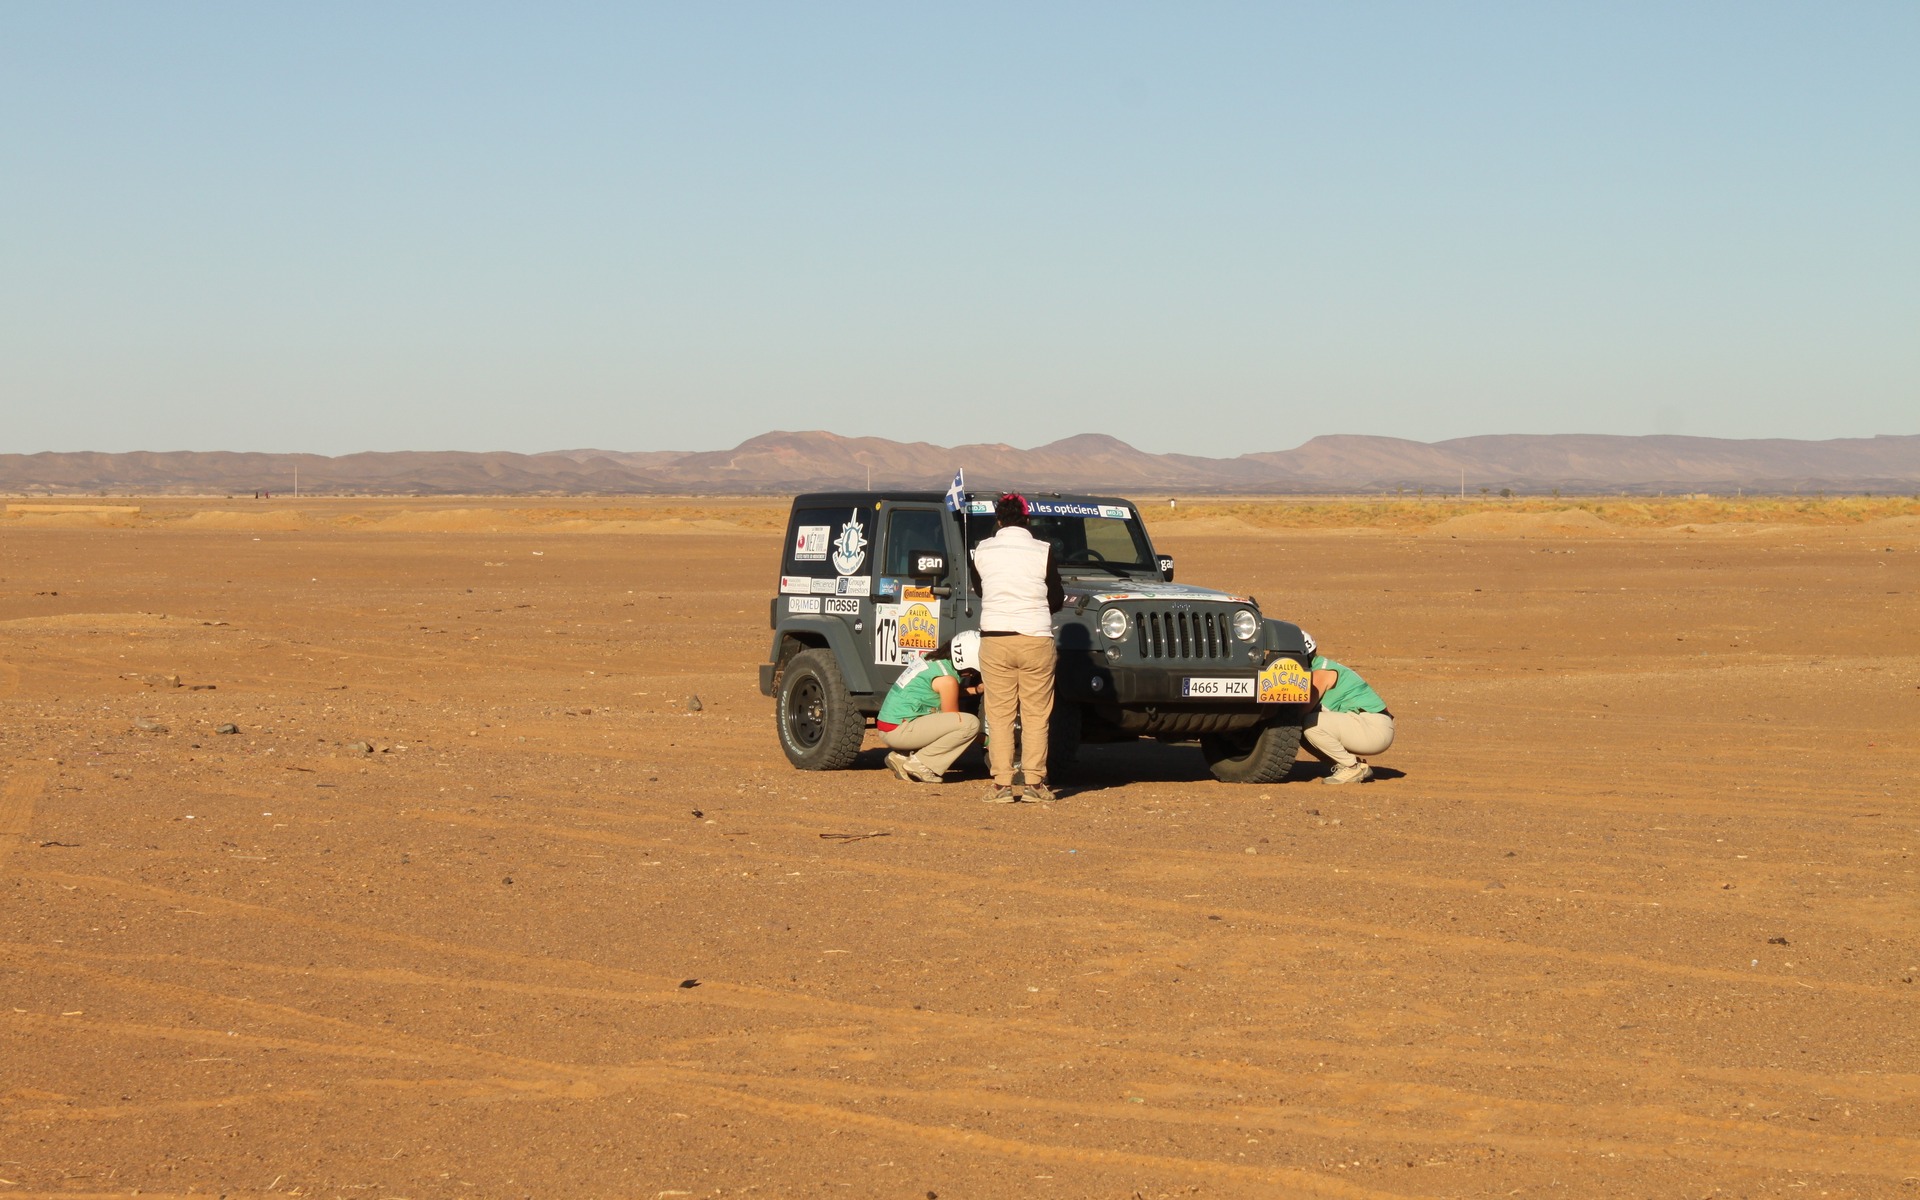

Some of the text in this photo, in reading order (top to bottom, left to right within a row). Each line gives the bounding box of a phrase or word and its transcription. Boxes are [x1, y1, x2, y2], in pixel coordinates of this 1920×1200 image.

[1037, 502, 1052, 513] les
[1054, 503, 1099, 516] opticiens
[917, 556, 943, 570] gan
[826, 598, 858, 612] masse
[909, 609, 928, 617] RALLYE
[877, 618, 897, 662] 173
[899, 638, 936, 649] GAZELLES
[954, 643, 964, 663] 173
[1274, 663, 1298, 671] RALLYE
[1191, 682, 1248, 694] 4665 HZK
[1260, 693, 1309, 702] GAZELLES
